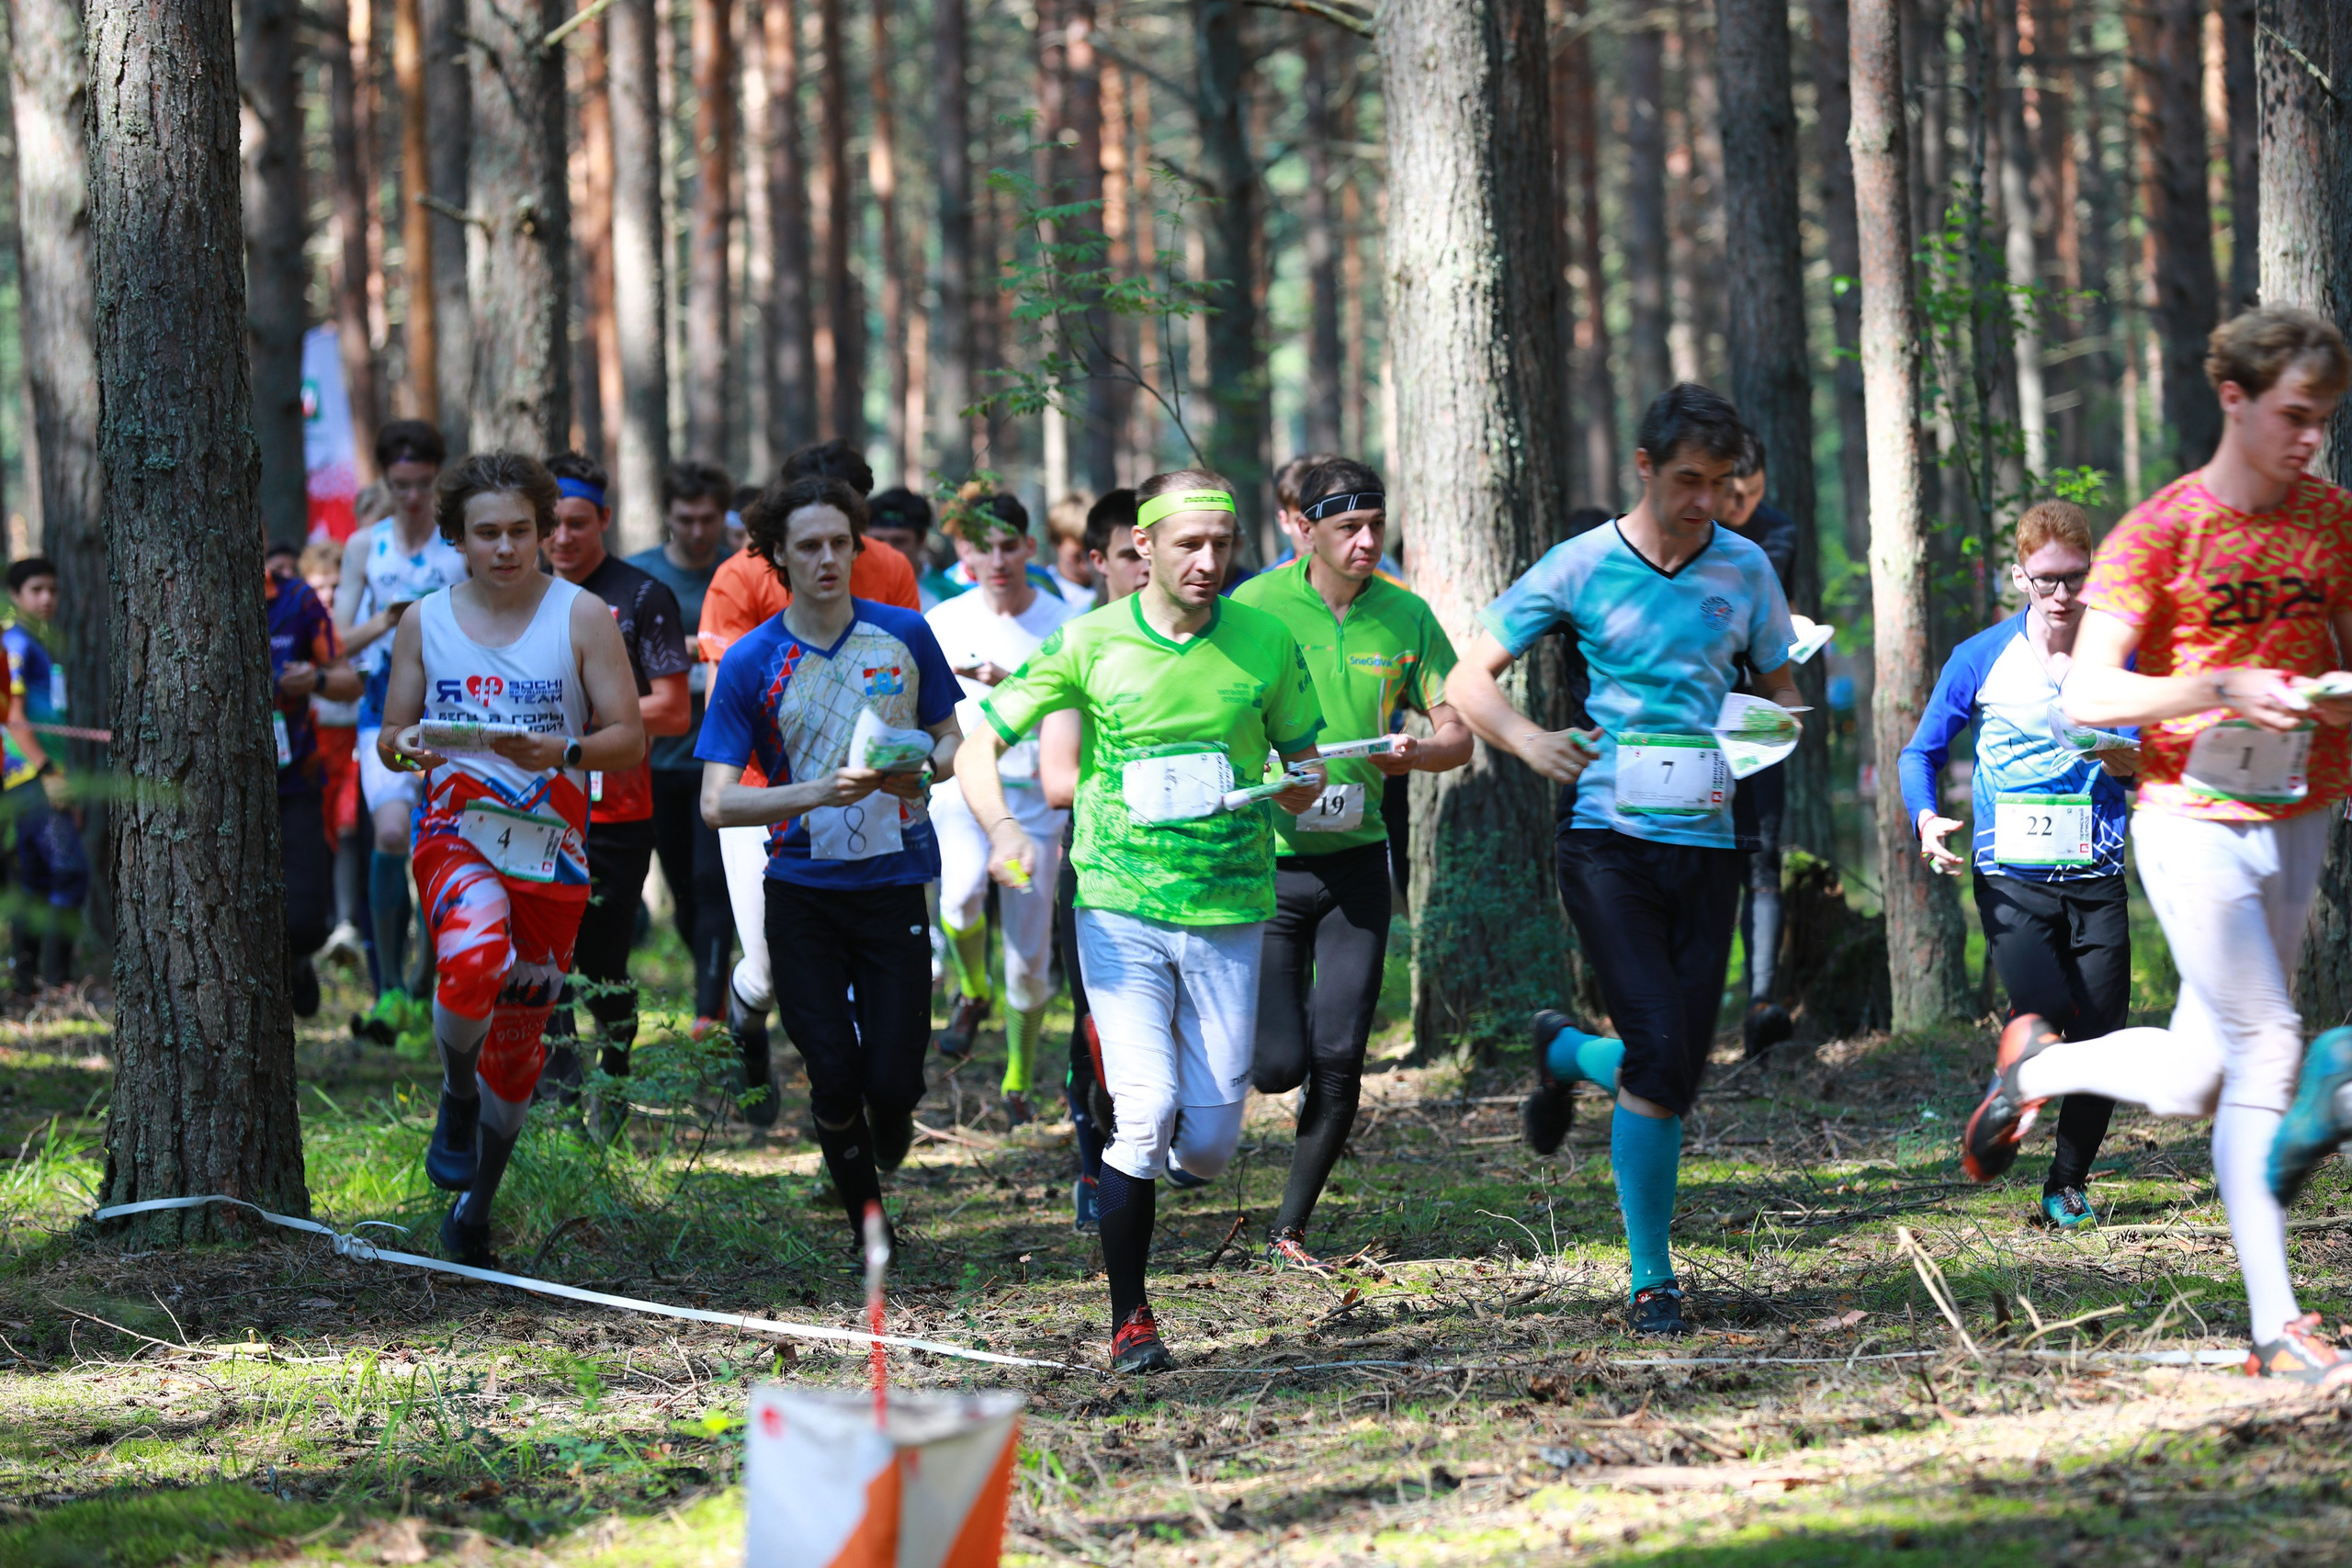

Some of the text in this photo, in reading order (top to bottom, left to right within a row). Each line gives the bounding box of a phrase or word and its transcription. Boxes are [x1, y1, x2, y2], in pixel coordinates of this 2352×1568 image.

[436, 680, 463, 703] Я
[509, 679, 562, 689] SOCHI
[509, 694, 562, 705] TEAM
[512, 712, 564, 724] ГОРЫ
[1660, 761, 1675, 784] 7
[1320, 795, 1345, 816] 19
[843, 805, 866, 854] 8
[2026, 816, 2052, 836] 22
[497, 826, 512, 849] 4
